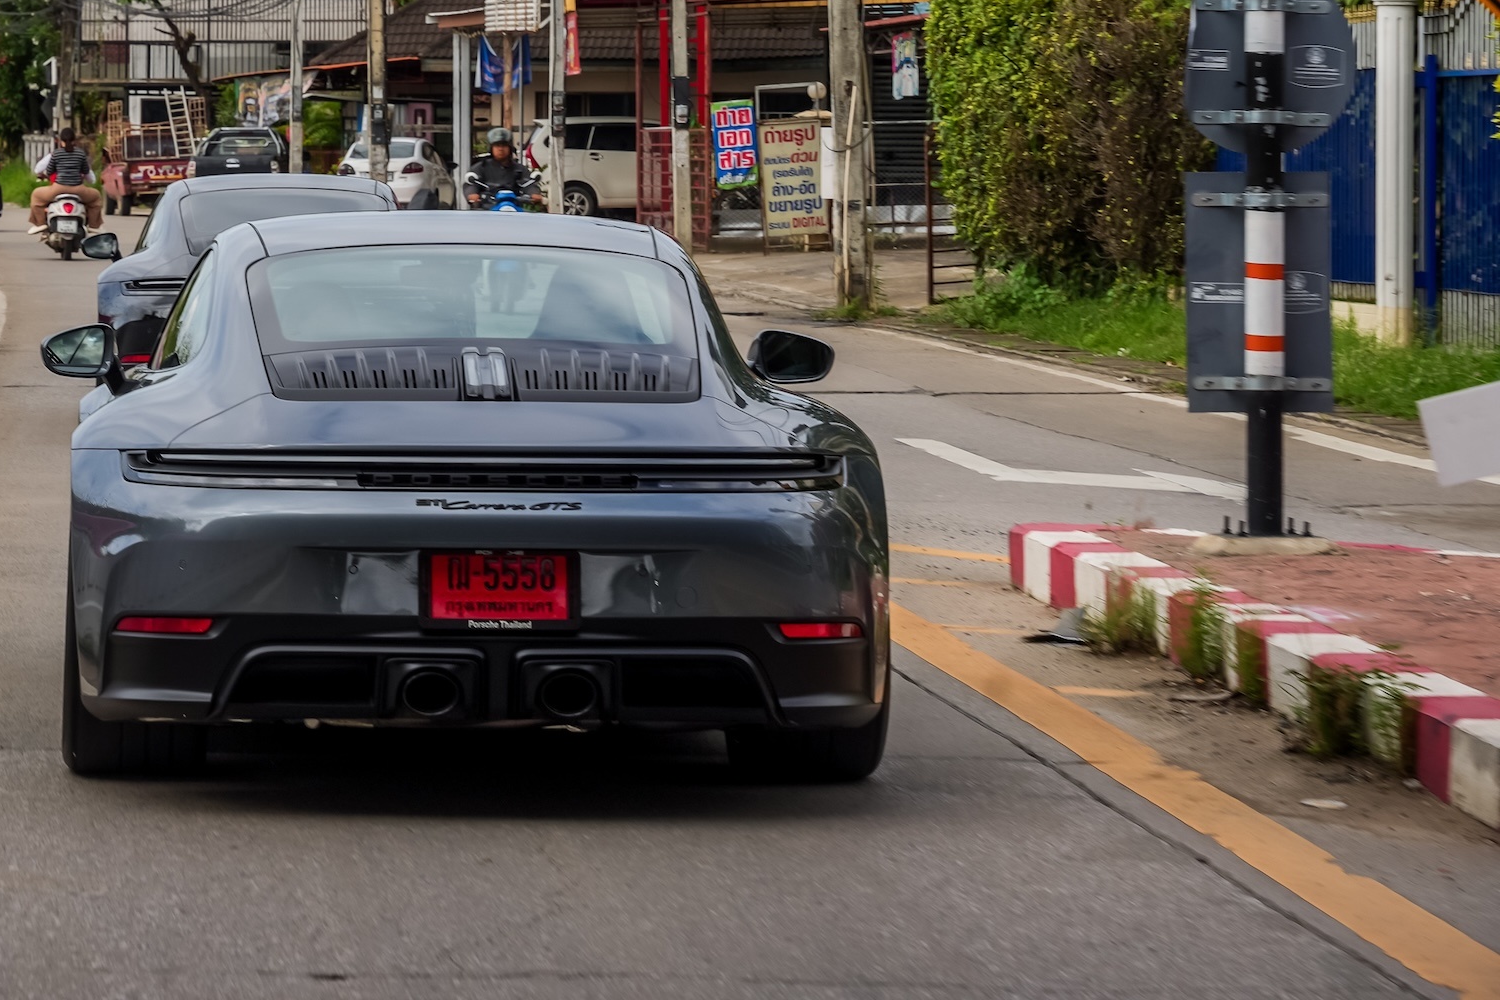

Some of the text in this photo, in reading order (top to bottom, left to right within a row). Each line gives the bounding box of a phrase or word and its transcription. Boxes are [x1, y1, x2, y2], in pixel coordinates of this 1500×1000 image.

[716, 107, 752, 128] ถ่าย
[718, 129, 752, 148] เอก
[764, 124, 816, 146] ถ่ายรูป
[719, 150, 755, 170] สาร
[138, 165, 188, 177] TOYOT
[772, 180, 816, 197] ล้าง-อัด
[768, 195, 823, 214] ขยายรูป
[792, 215, 827, 229] DIGITAL
[442, 500, 527, 511] Carrera
[528, 502, 583, 511] GTS
[468, 620, 533, 629] Porsche Thailand
